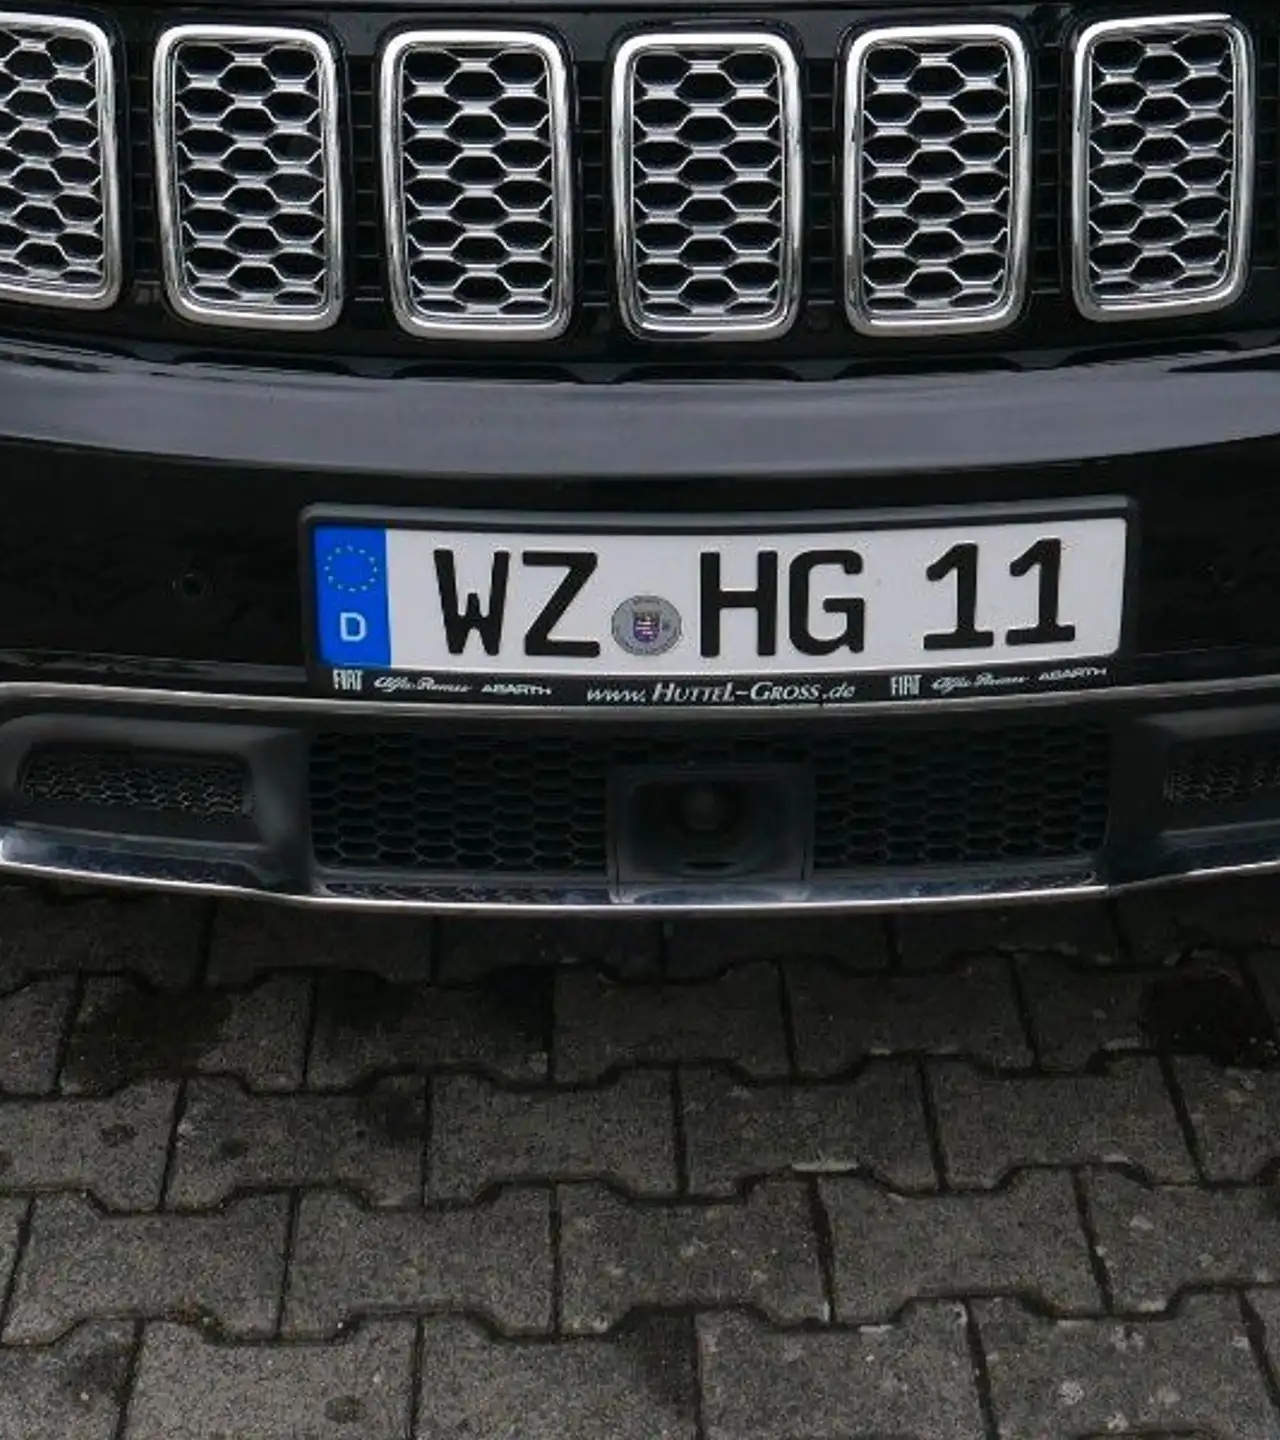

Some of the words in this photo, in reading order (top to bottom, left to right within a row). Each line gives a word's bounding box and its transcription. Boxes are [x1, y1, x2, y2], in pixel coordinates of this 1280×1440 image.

[433, 548, 600, 657] WZ
[699, 549, 865, 657] HG
[923, 537, 1076, 651] 11
[339, 611, 368, 643] D
[333, 668, 363, 691] FIAT
[481, 683, 552, 696] ABARTH
[890, 673, 922, 697] FIAT
